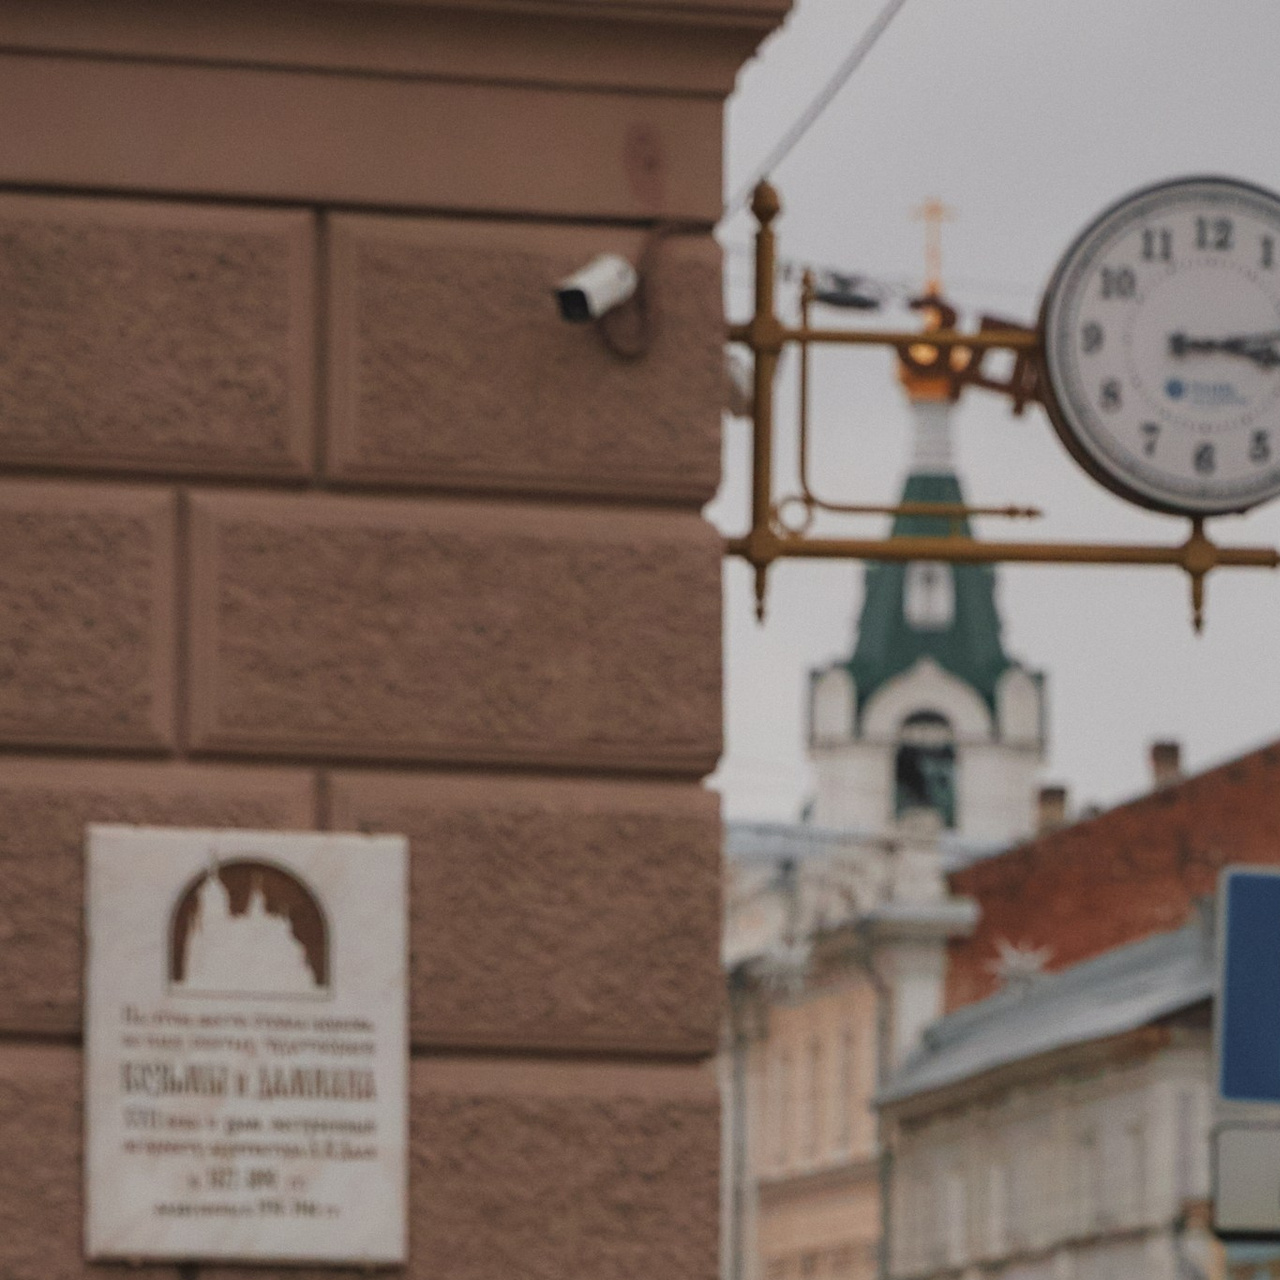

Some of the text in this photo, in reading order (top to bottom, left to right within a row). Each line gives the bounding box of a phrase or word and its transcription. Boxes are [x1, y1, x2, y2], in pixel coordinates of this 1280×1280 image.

[1142, 228, 1171, 261] 11
[1196, 215, 1232, 251] 12
[1260, 235, 1274, 270] 1
[1101, 266, 1135, 299] 10
